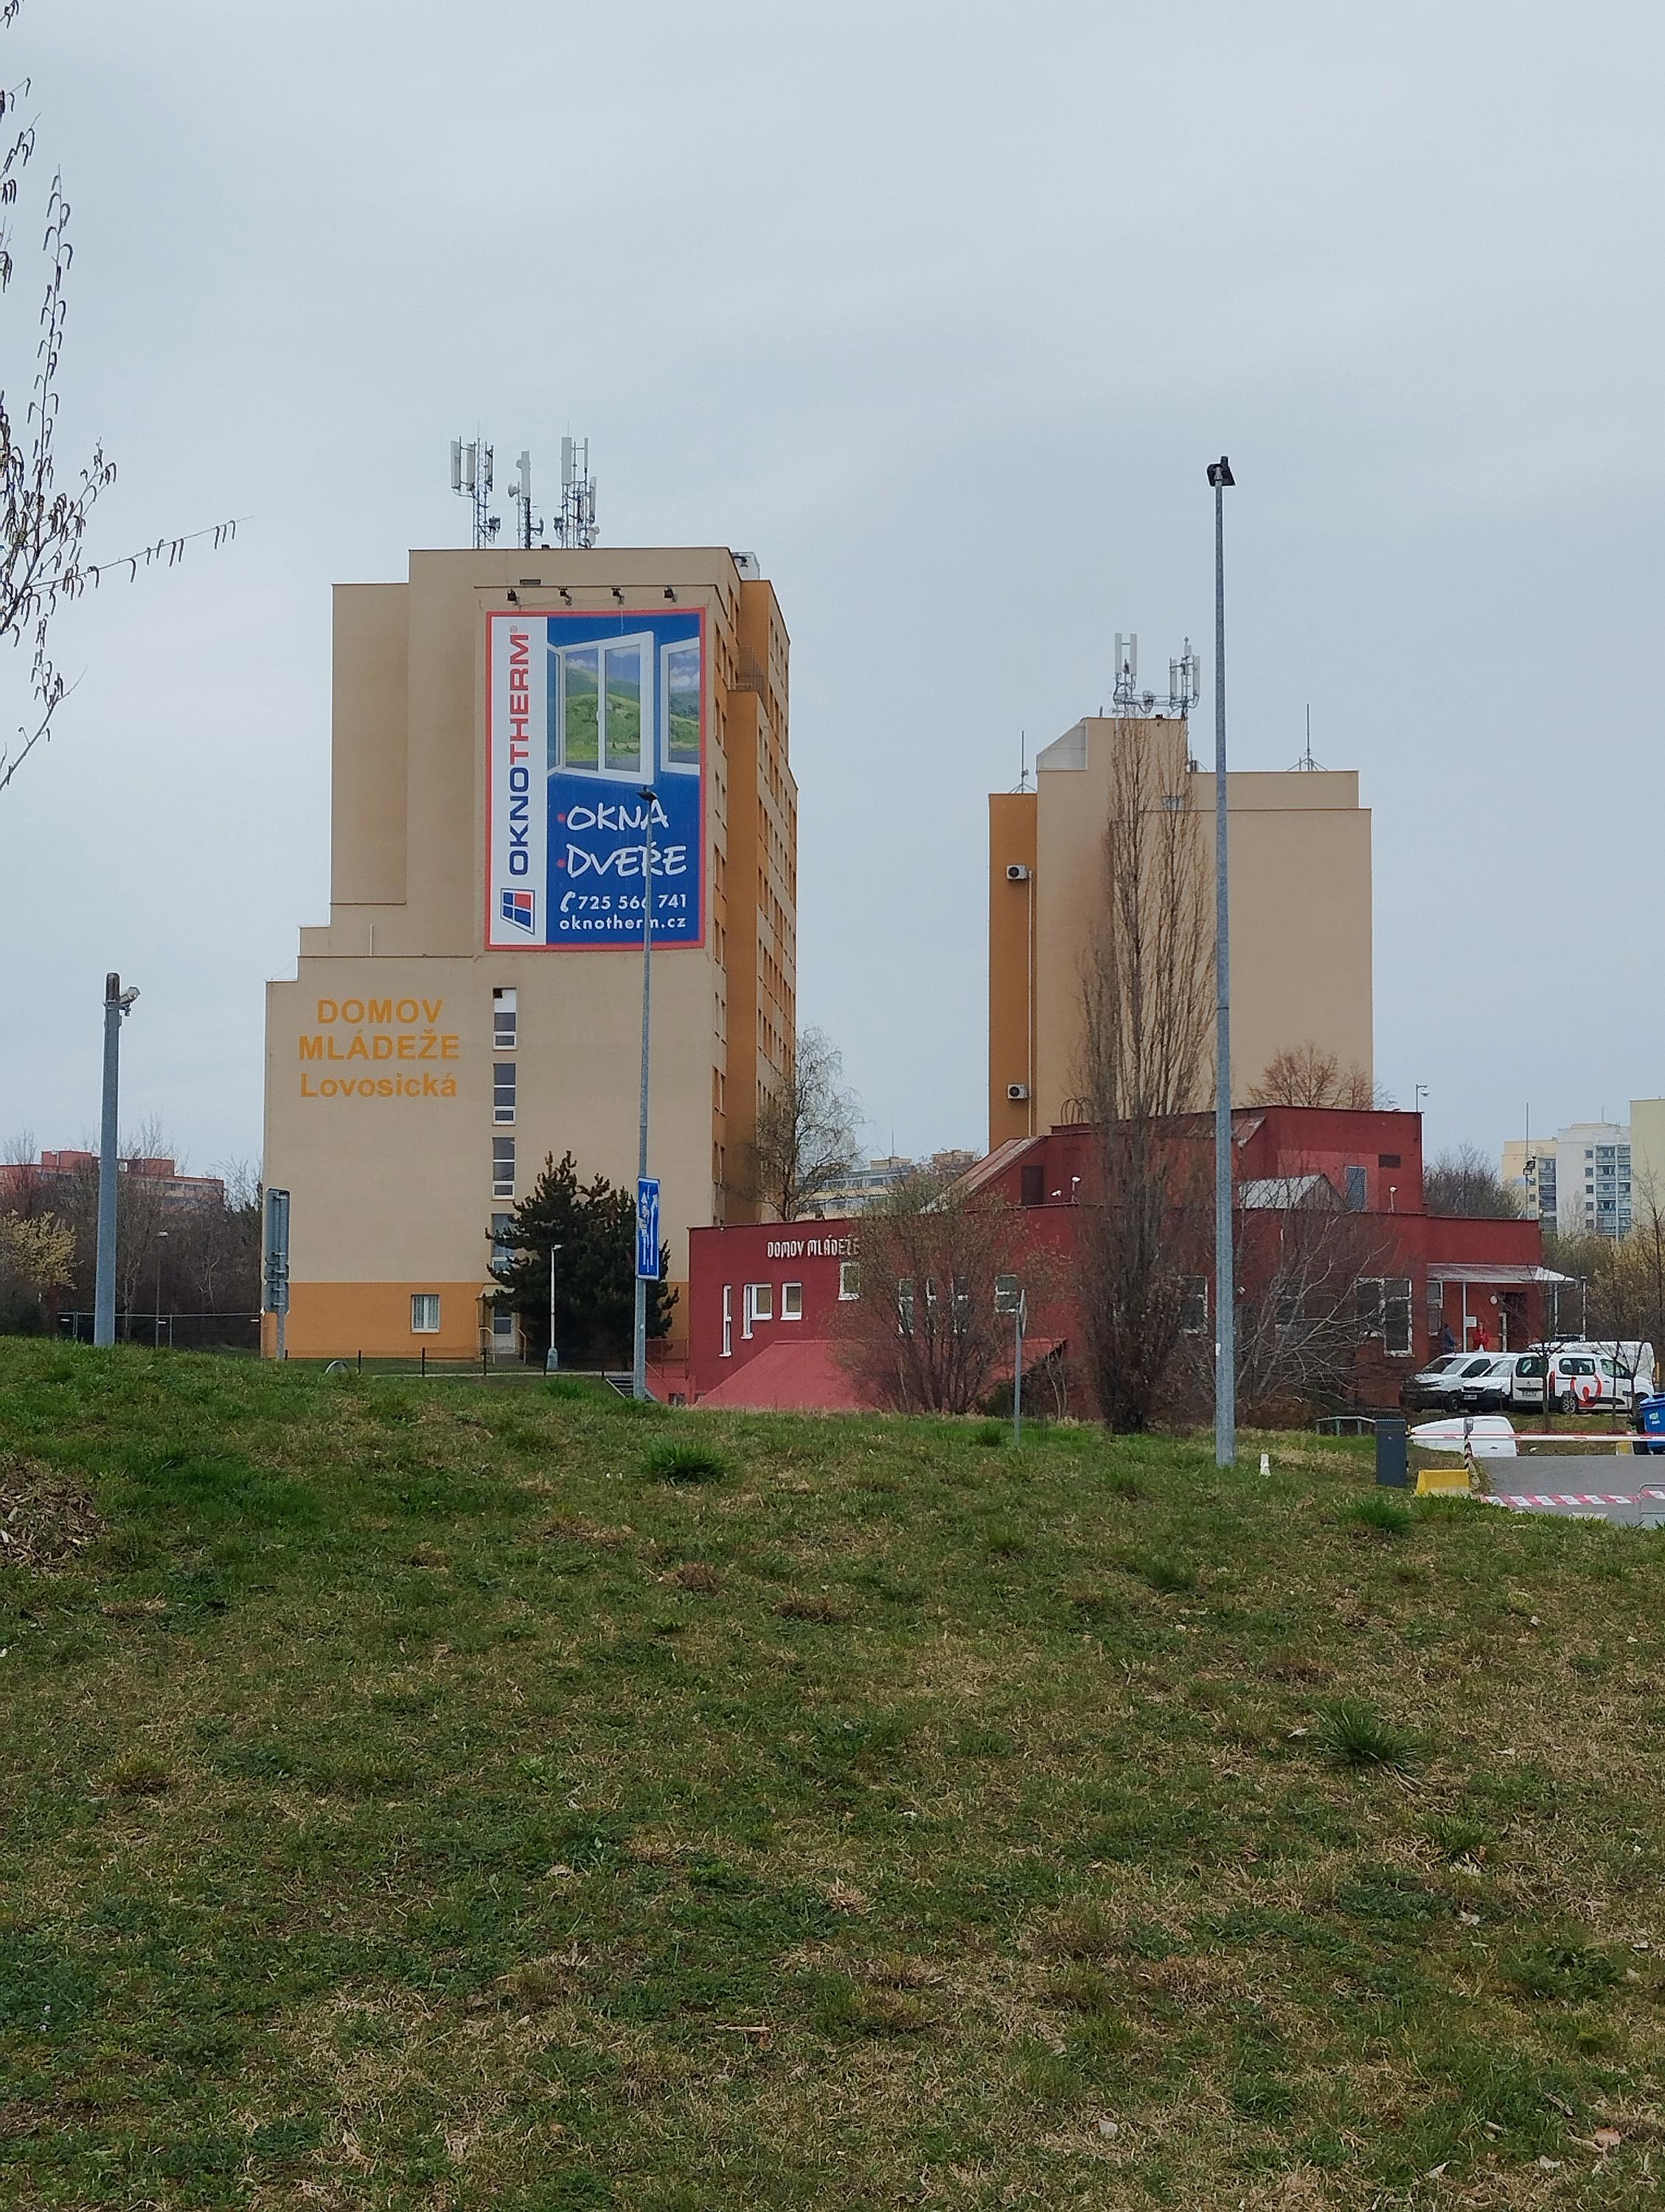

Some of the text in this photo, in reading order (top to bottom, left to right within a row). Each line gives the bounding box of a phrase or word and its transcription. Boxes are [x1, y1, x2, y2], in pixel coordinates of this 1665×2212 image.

[566, 799, 670, 831] OKNA
[566, 841, 687, 878] DVEŘE
[578, 895, 611, 910] 725
[658, 894, 686, 908] 741
[317, 998, 442, 1024] DOMOV
[299, 1029, 460, 1060] MLÁDEŽE
[300, 1072, 458, 1098] Lovosická
[767, 1240, 805, 1259] DOMOV
